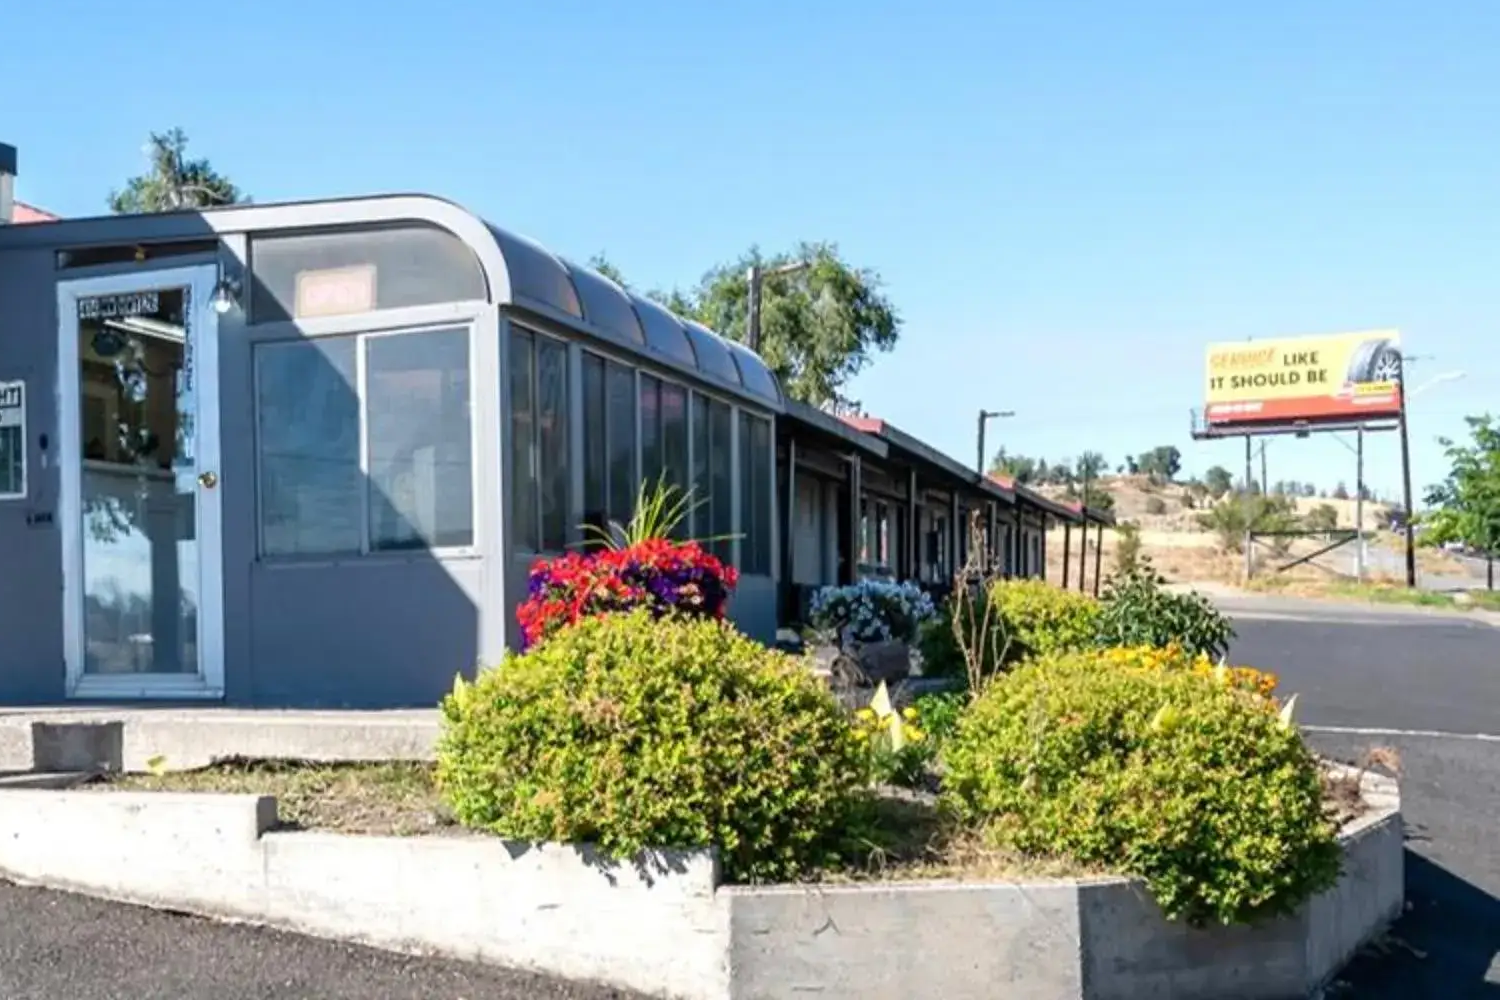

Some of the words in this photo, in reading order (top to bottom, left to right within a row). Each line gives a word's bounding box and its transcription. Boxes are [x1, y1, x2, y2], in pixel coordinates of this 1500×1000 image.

[1283, 350, 1320, 367] LIKE
[1210, 376, 1225, 391] IT
[1230, 370, 1301, 390] SHOULD
[1306, 368, 1328, 384] BE
